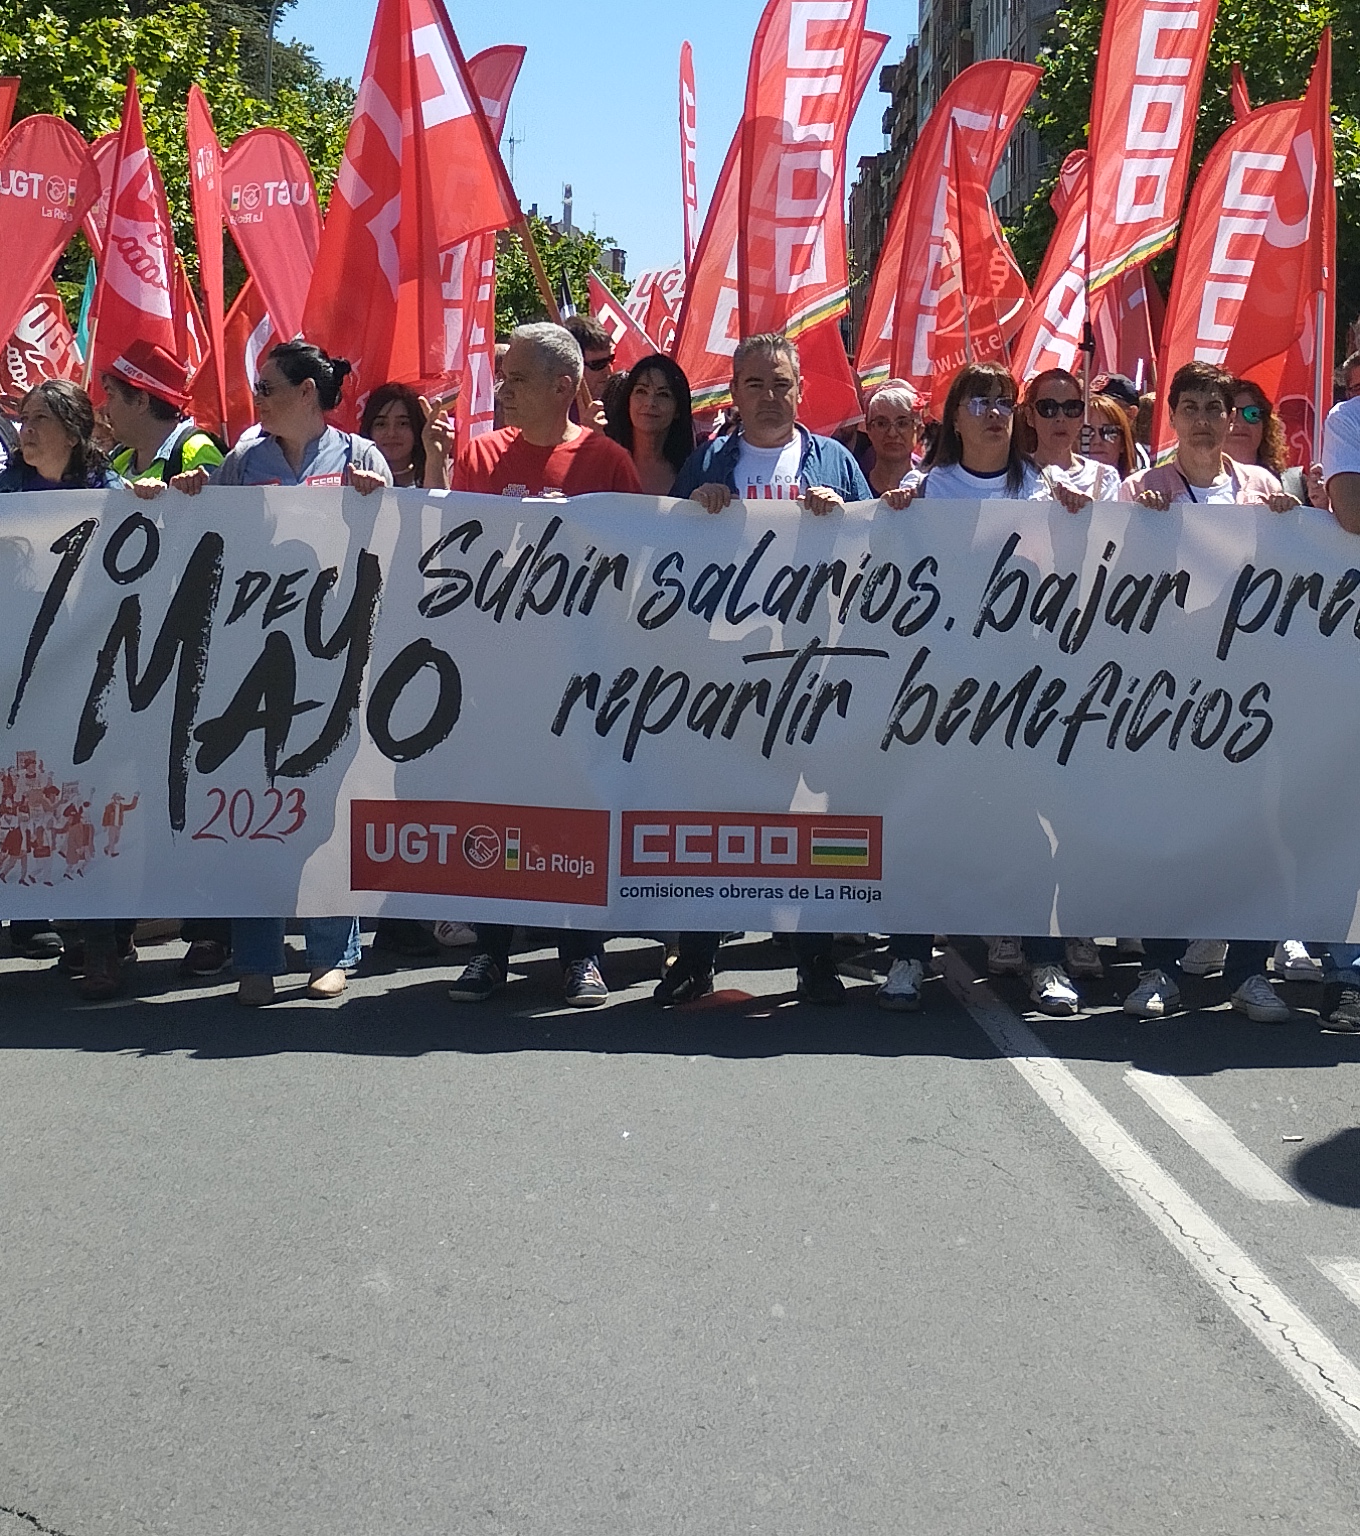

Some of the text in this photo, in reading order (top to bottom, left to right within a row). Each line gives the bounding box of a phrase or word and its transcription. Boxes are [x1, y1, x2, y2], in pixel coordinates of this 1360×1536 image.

[775, 0, 854, 294] CCOO
[635, 268, 686, 298] UG
[224, 568, 304, 629] DE
[417, 517, 631, 623] Subir
[972, 531, 1190, 654] bajar
[72, 529, 463, 834] MAYO
[551, 636, 1274, 766] repartir beneficios
[191, 786, 308, 845] 2023
[633, 825, 798, 866] CCOO
[364, 822, 596, 879] UGT La Rioja
[619, 884, 883, 904] comisiones obreras de La Rioja
